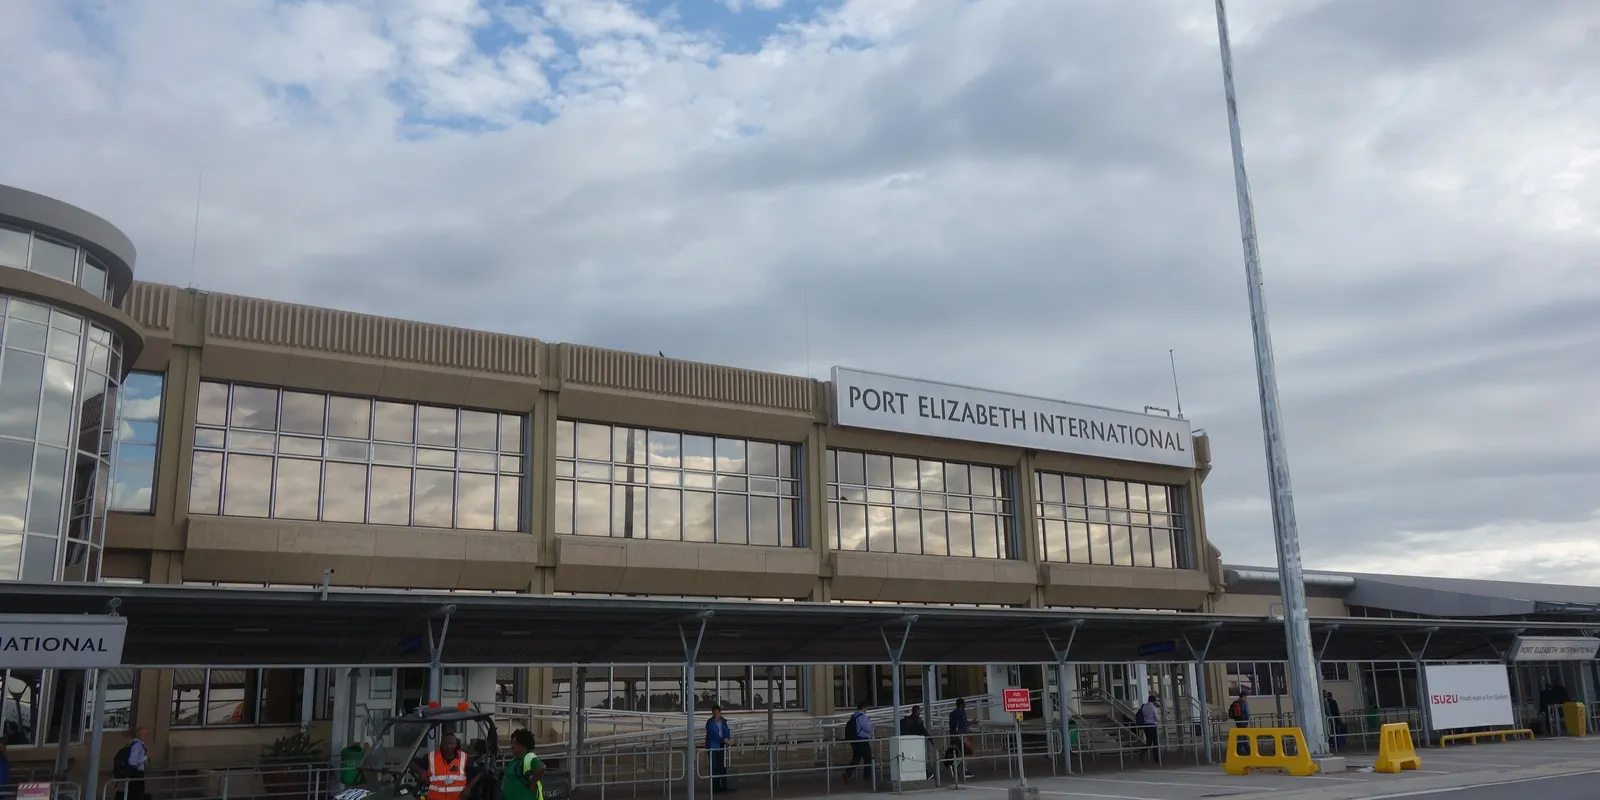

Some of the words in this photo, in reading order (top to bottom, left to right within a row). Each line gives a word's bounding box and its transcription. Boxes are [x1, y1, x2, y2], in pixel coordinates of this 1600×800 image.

[849, 386, 908, 415] PORT
[919, 395, 1027, 431] ELIZABETH
[1034, 411, 1185, 452] INTERNATIONAL
[1431, 694, 1459, 704] ISUZU
